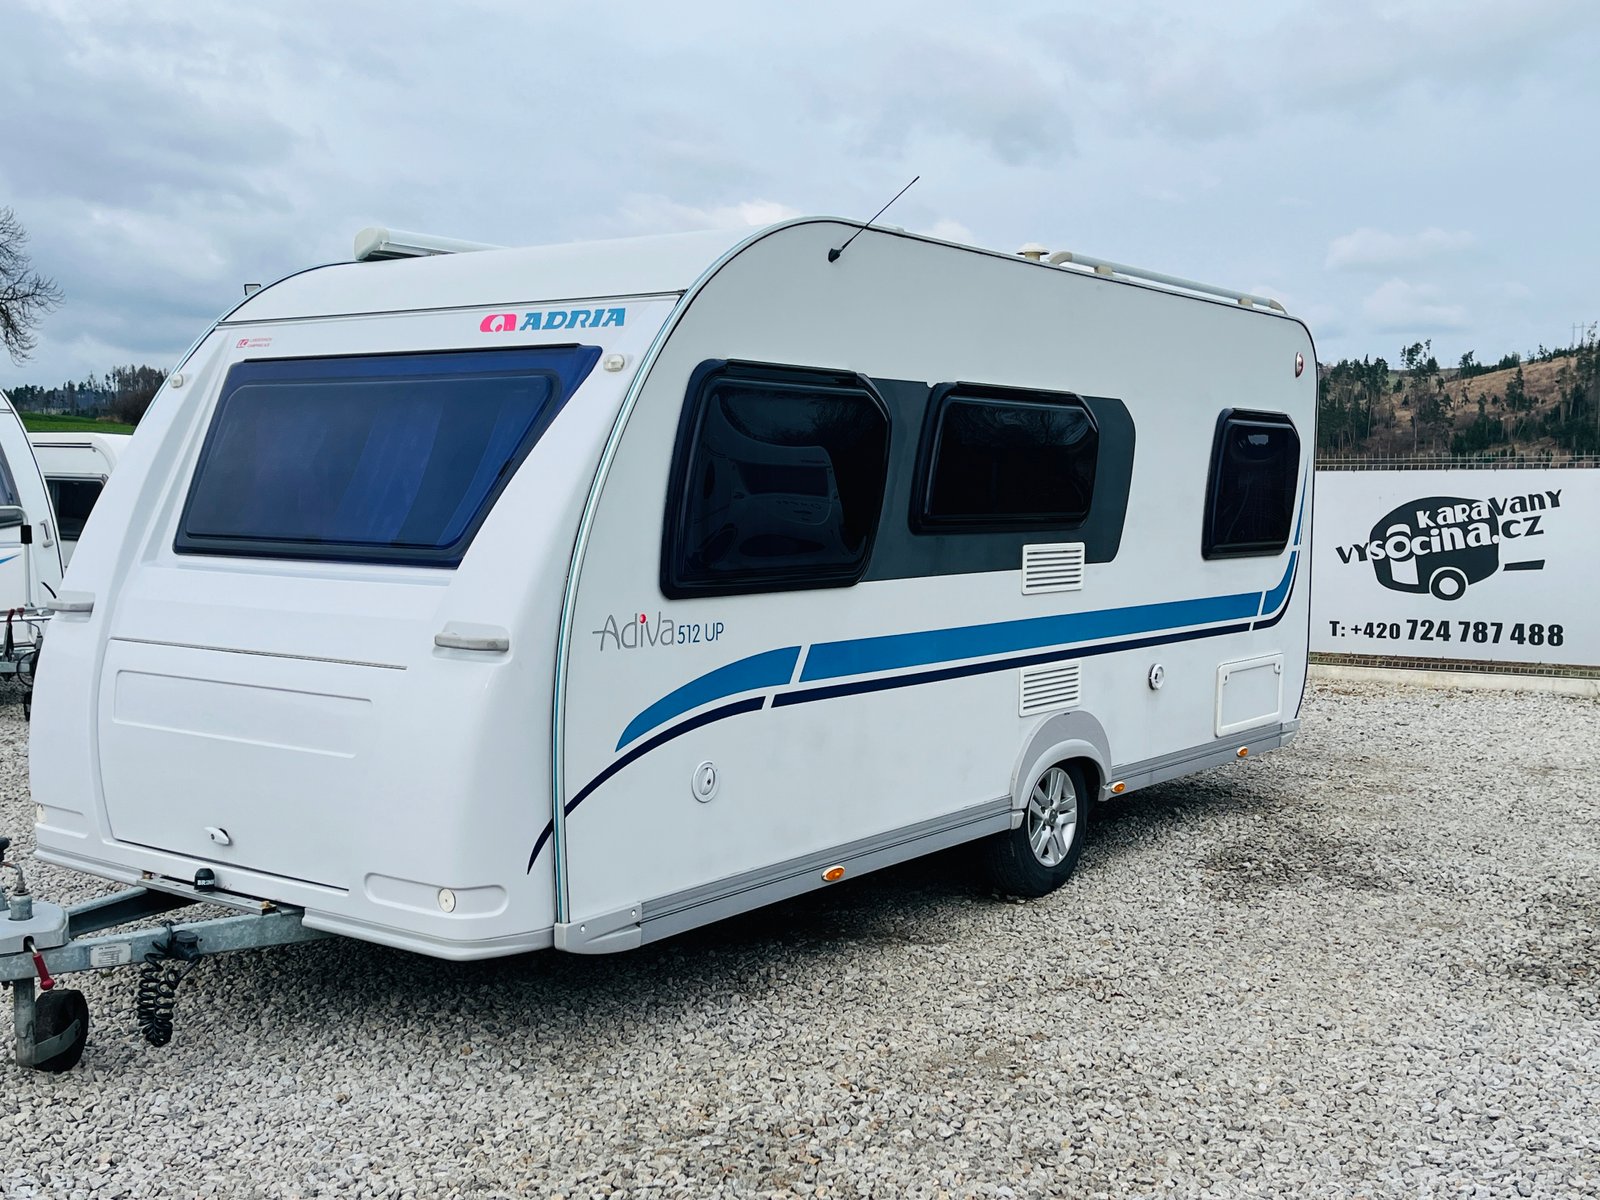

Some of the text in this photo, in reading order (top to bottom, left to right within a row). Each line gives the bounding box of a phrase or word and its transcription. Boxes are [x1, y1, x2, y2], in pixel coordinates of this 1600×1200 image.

[519, 307, 626, 331] ADRIA
[677, 624, 701, 644] 512
[705, 622, 724, 641] UP
[1329, 619, 1564, 647] T: +420 724 787 488
